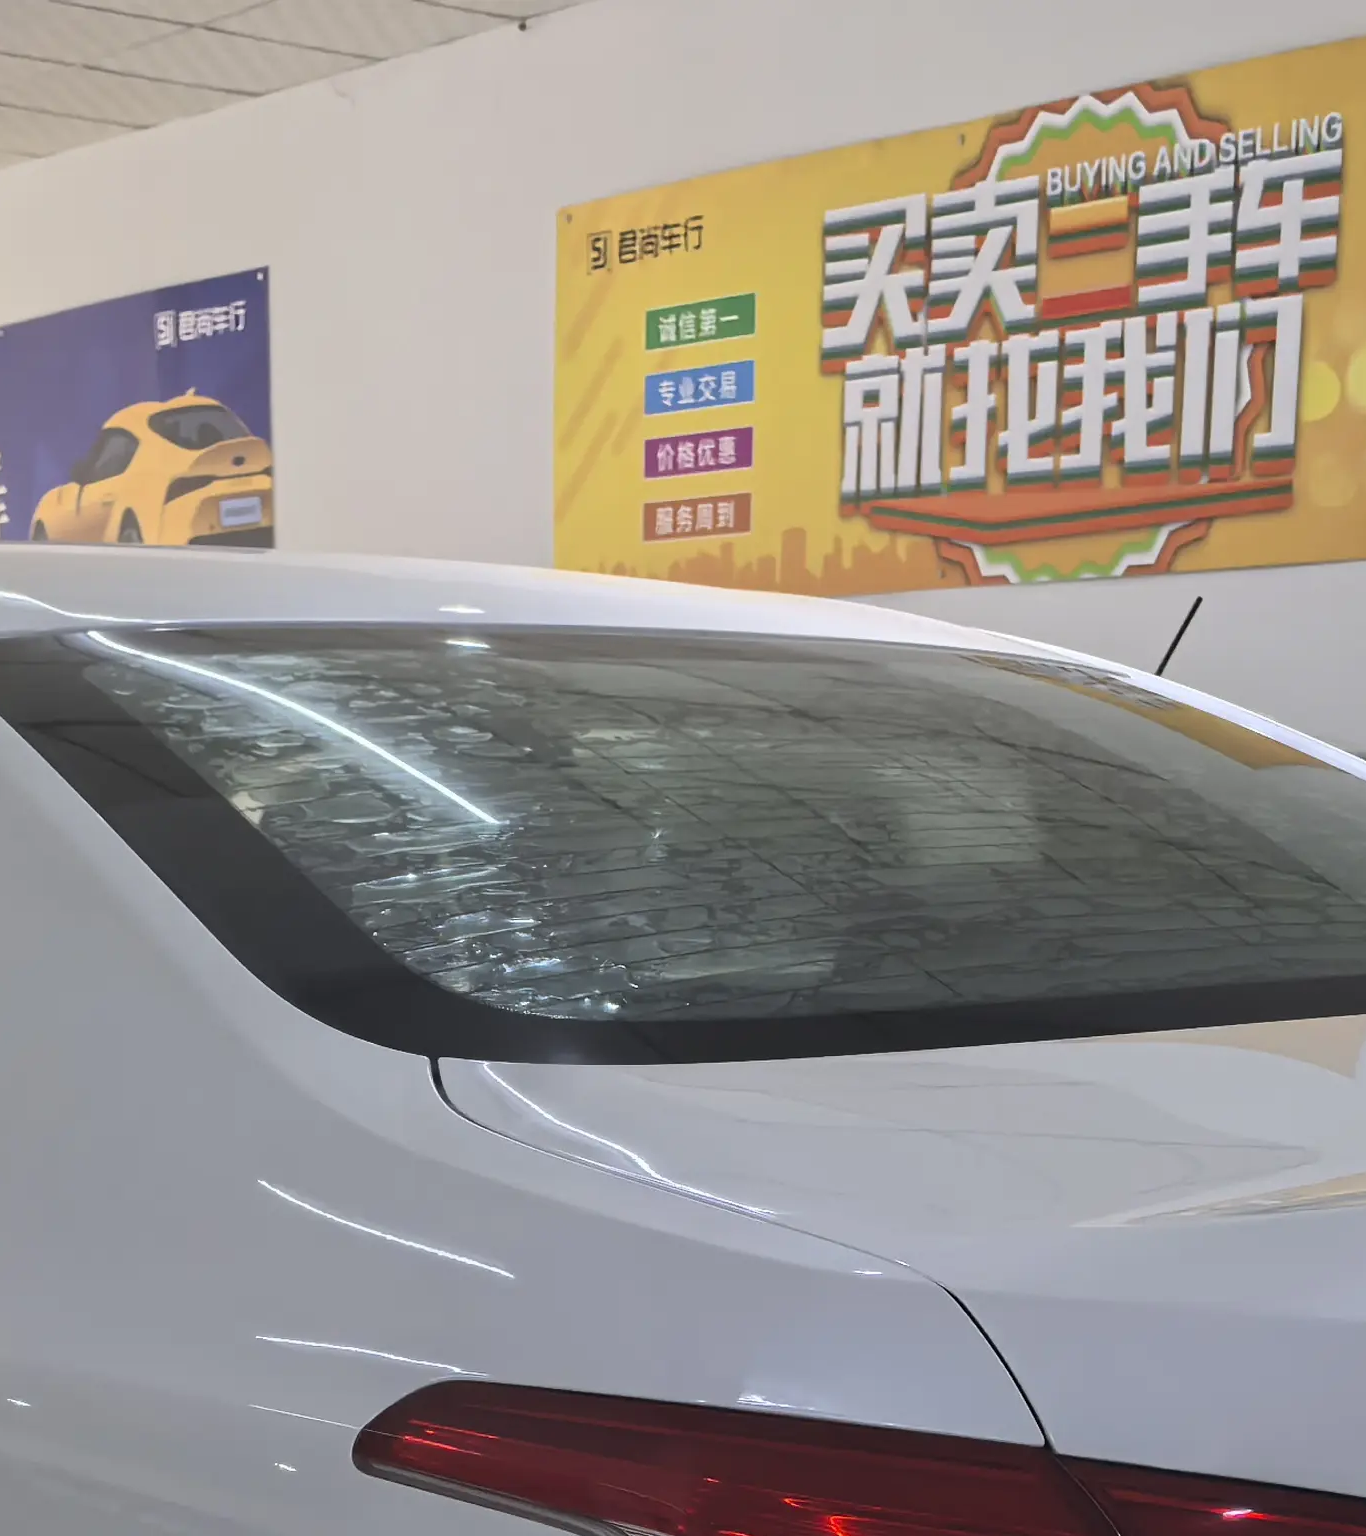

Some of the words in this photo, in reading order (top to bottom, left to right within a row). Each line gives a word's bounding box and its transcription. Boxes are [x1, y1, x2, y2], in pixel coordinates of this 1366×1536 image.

[1046, 151, 1147, 196] BUYING
[1153, 138, 1217, 176] AND
[1218, 111, 1344, 163] SELLING
[617, 214, 704, 265] 君尚车行
[822, 149, 1343, 350] 买卖二手车
[658, 307, 740, 343] 诚信第一
[657, 370, 738, 407] 专业交易
[841, 293, 1304, 497] 就找我们
[657, 435, 737, 473] 价格优惠
[655, 500, 735, 536] 服务周到
